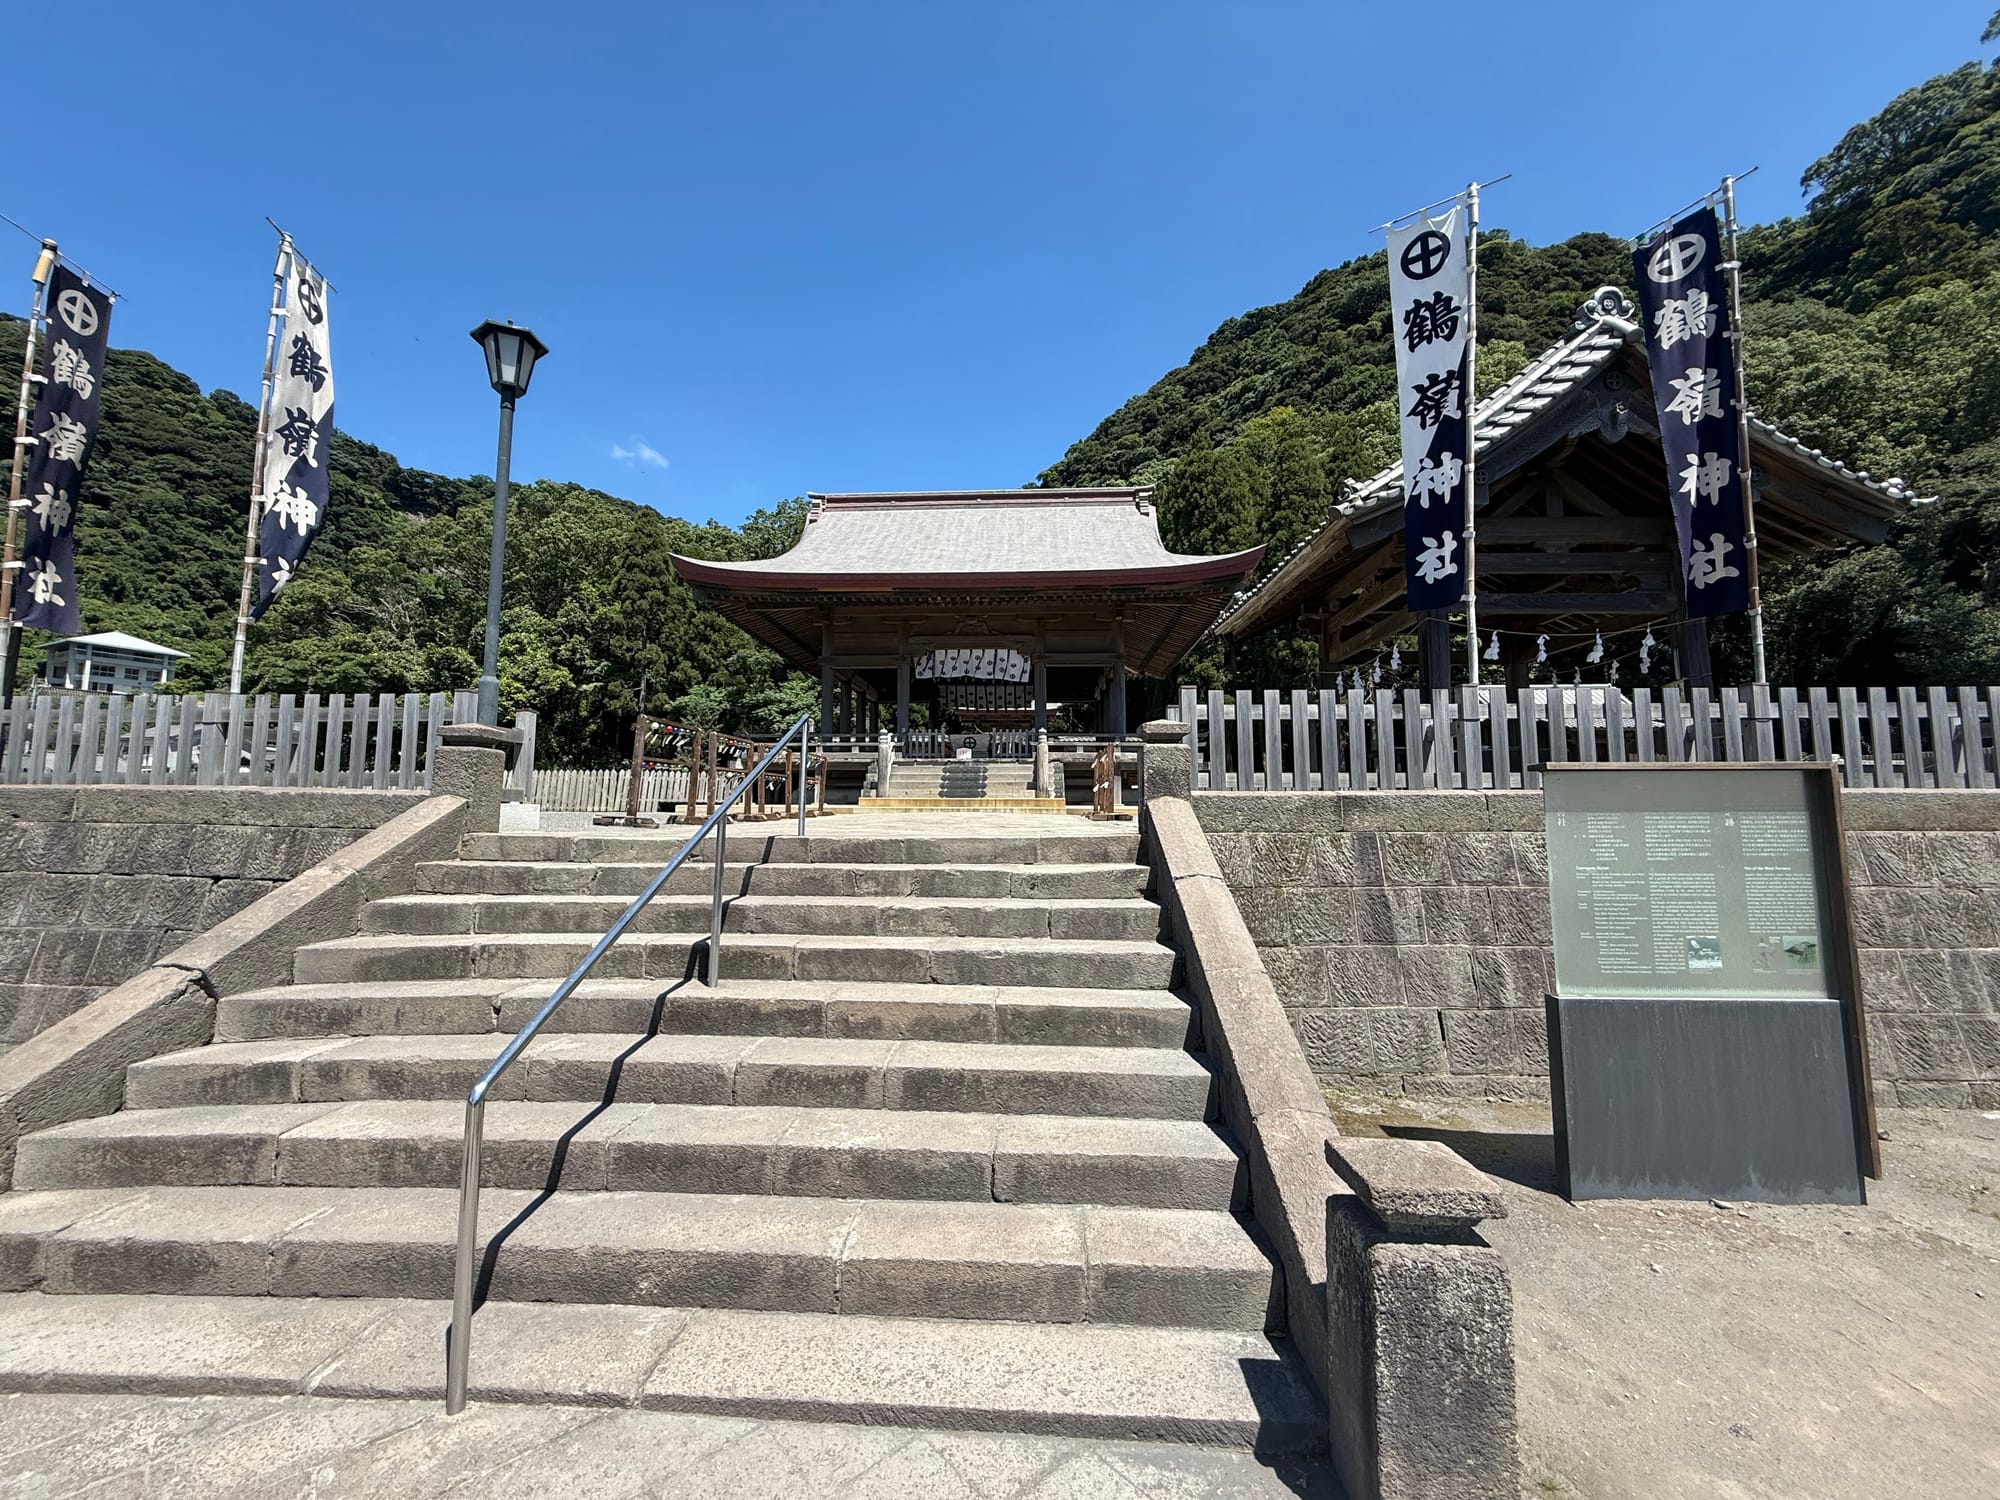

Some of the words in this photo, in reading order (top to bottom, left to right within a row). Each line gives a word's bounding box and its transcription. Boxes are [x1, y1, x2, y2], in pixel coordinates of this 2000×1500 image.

[27, 337, 96, 608] 鶴嶺神社
[1402, 290, 1464, 585] 鶴嶺神社
[1653, 288, 1741, 590] 鶴嶺神社
